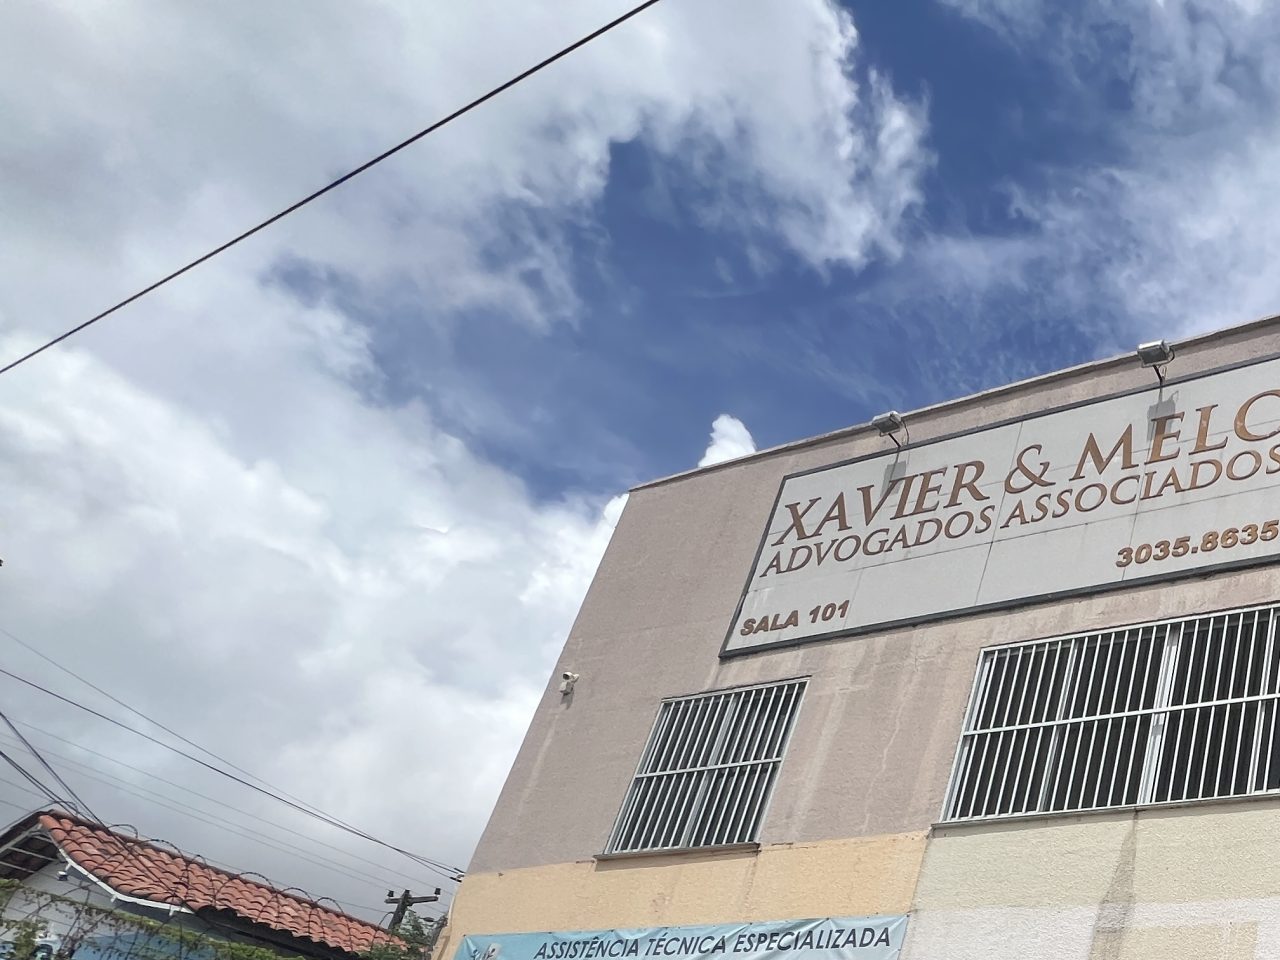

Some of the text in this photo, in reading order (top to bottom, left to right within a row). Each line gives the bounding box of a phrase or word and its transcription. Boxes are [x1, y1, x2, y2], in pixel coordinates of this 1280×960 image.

[771, 460, 990, 547] XAVIER
[1004, 444, 1056, 494] &
[759, 505, 995, 577] ADVOGADOS
[1115, 519, 1280, 568] 3035.8635
[740, 600, 850, 636] SALA 101
[533, 927, 891, 960] ASSISTÊNCIA TÉCNICA ESPECIALIZADA
